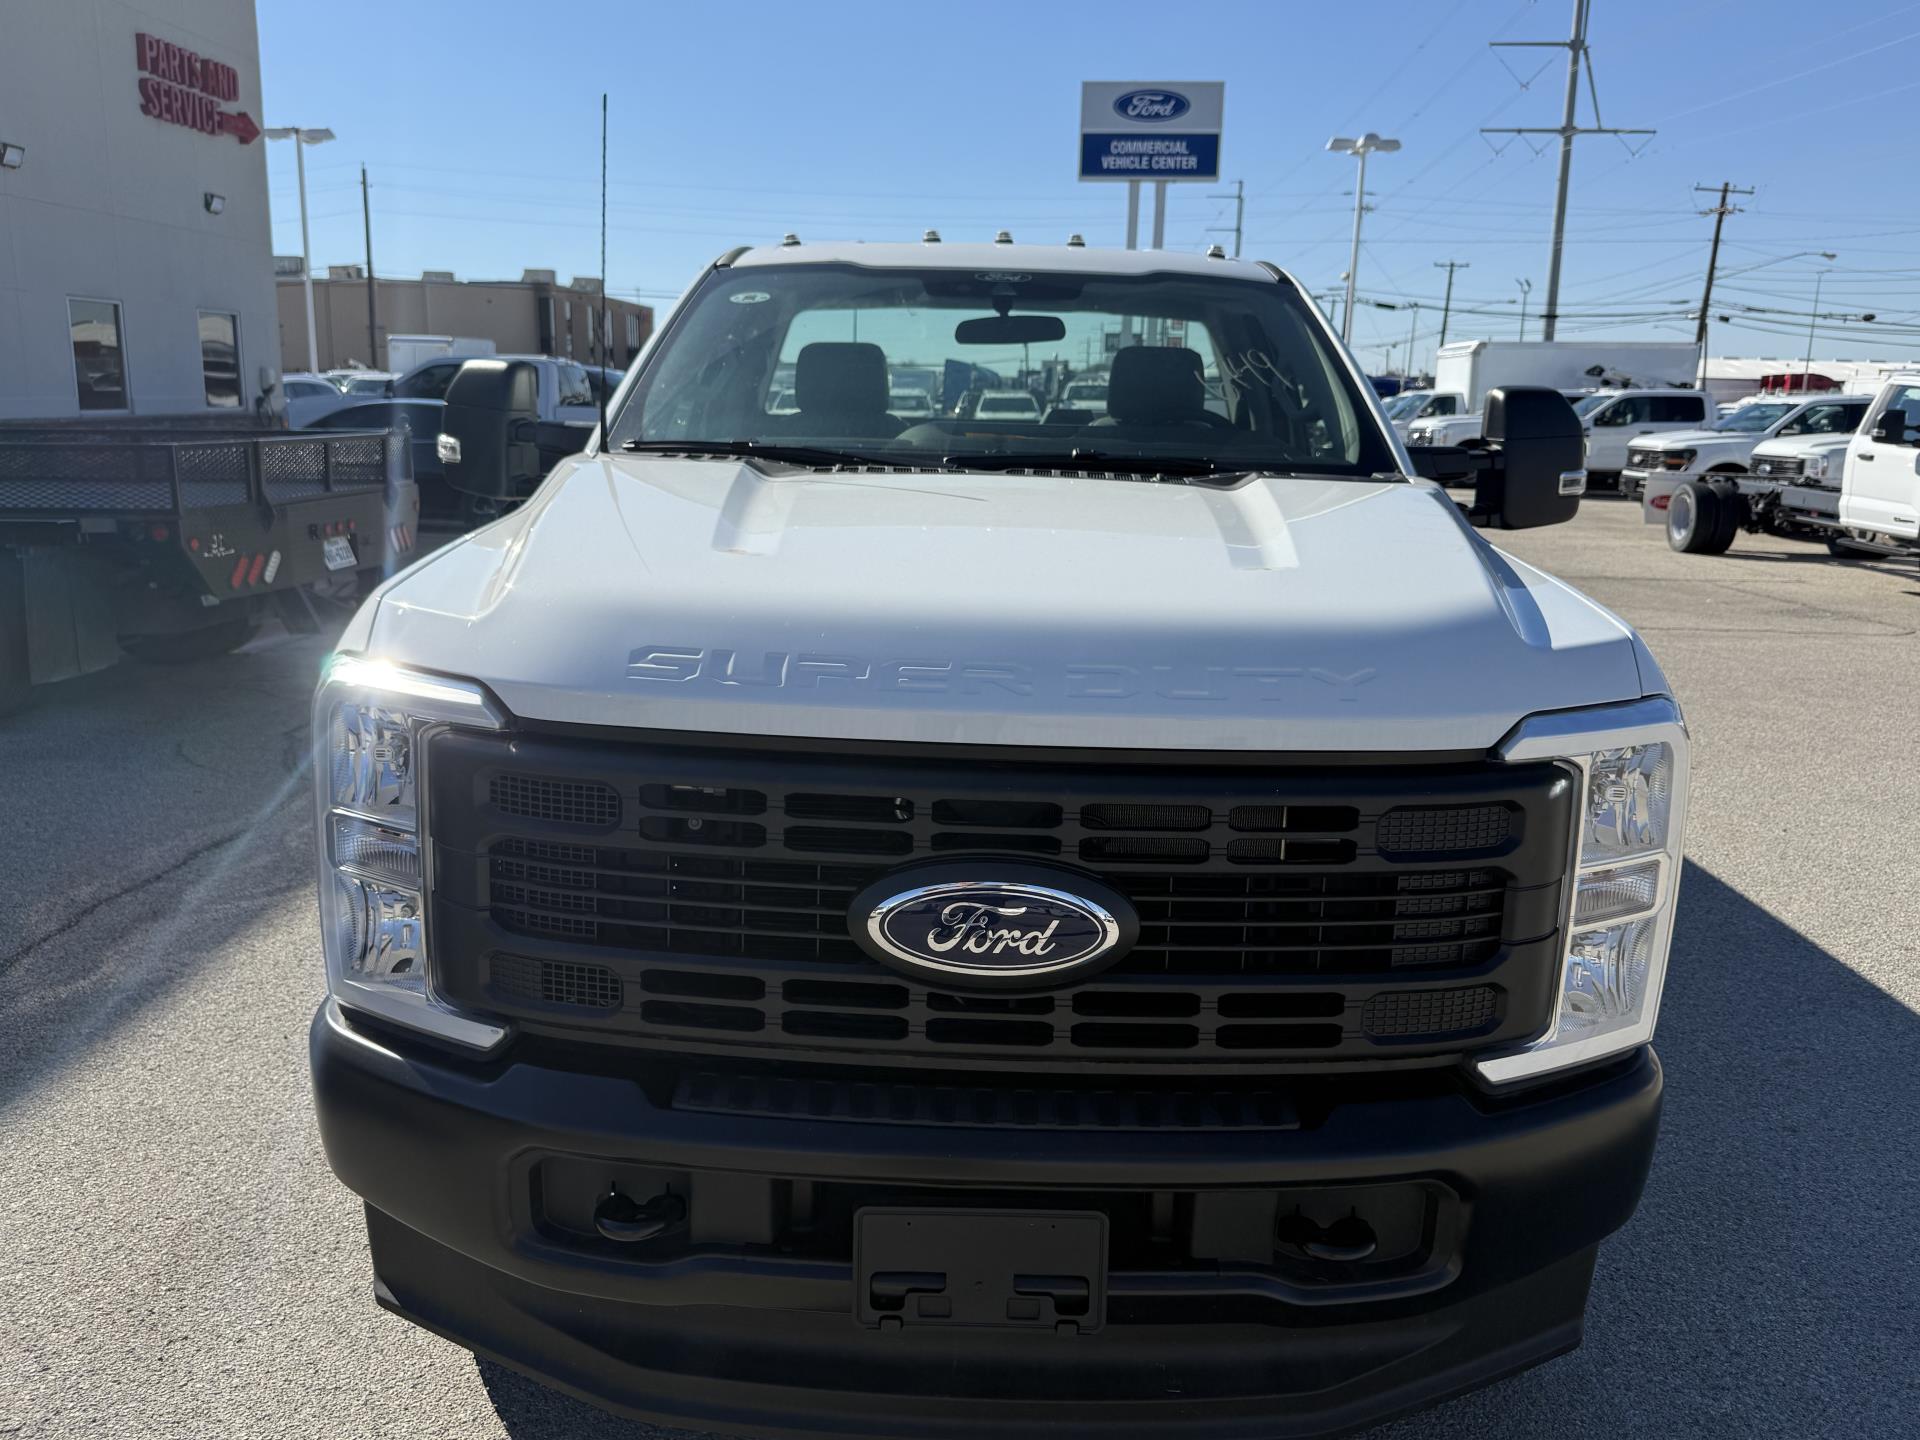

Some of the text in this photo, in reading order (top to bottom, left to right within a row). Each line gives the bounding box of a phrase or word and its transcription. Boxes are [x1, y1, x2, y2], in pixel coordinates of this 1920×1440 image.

[138, 33, 240, 103] PARTS AND
[139, 79, 223, 136] SERVICE
[1126, 95, 1177, 117] Ford
[1101, 156, 1198, 170] VEHICLE CENTER
[1109, 140, 1190, 155] COMMERCIAL
[626, 645, 1377, 702] SUPER DUTY
[927, 901, 1060, 956] Ford
